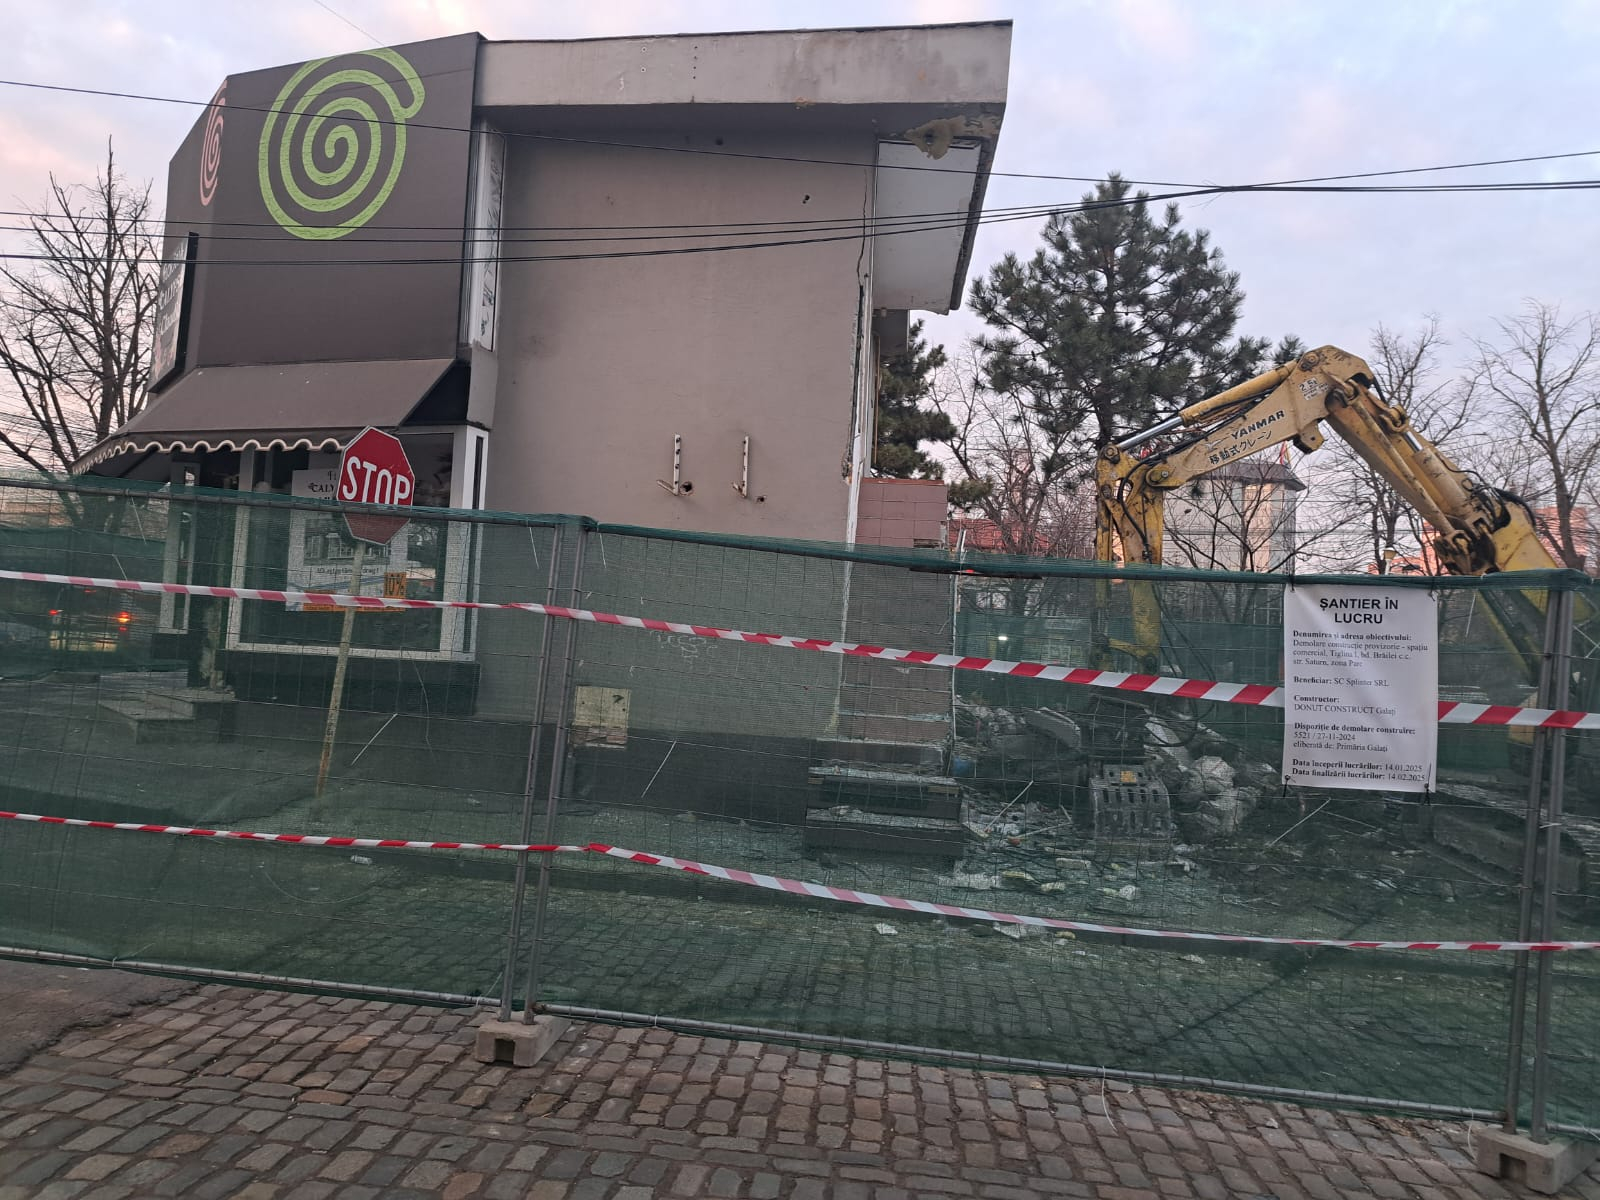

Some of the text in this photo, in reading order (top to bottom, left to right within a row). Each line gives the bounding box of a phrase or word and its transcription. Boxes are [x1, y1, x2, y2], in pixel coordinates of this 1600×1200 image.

[1231, 410, 1285, 440] YANMAR
[1209, 430, 1272, 464] 移動式クレーン
[342, 456, 411, 505] STOP
[1320, 597, 1398, 611] ȘANTIER ÎN
[1335, 613, 1383, 624] LUCRU
[1293, 630, 1332, 639] Denumirea
[1340, 632, 1364, 640] adresa
[1366, 633, 1412, 641] obiectivului:
[1365, 643, 1400, 651] provizorie
[1407, 644, 1428, 652] spațiu
[1373, 652, 1397, 660] Brăilei
[1294, 676, 1332, 684] Beneficiar:
[1334, 677, 1345, 685] SC
[1374, 679, 1390, 687] SRL
[1294, 695, 1340, 703] Constructor:
[1294, 704, 1324, 712] DONUT
[1325, 705, 1374, 714] CONSTRUCT
[1294, 722, 1330, 731] Dispoziție
[1342, 724, 1374, 732] demolare
[1376, 727, 1416, 735] construire:
[1317, 732, 1356, 741] 27-11-2024
[1293, 741, 1323, 749] eliberată
[1336, 743, 1366, 751] Primăria
[1367, 744, 1388, 752] Galați
[1292, 759, 1423, 772] Data începerii lucrărilor: 14.01.2025
[1312, 769, 1346, 778] finalizării
[1347, 771, 1385, 780] lucrărilor:
